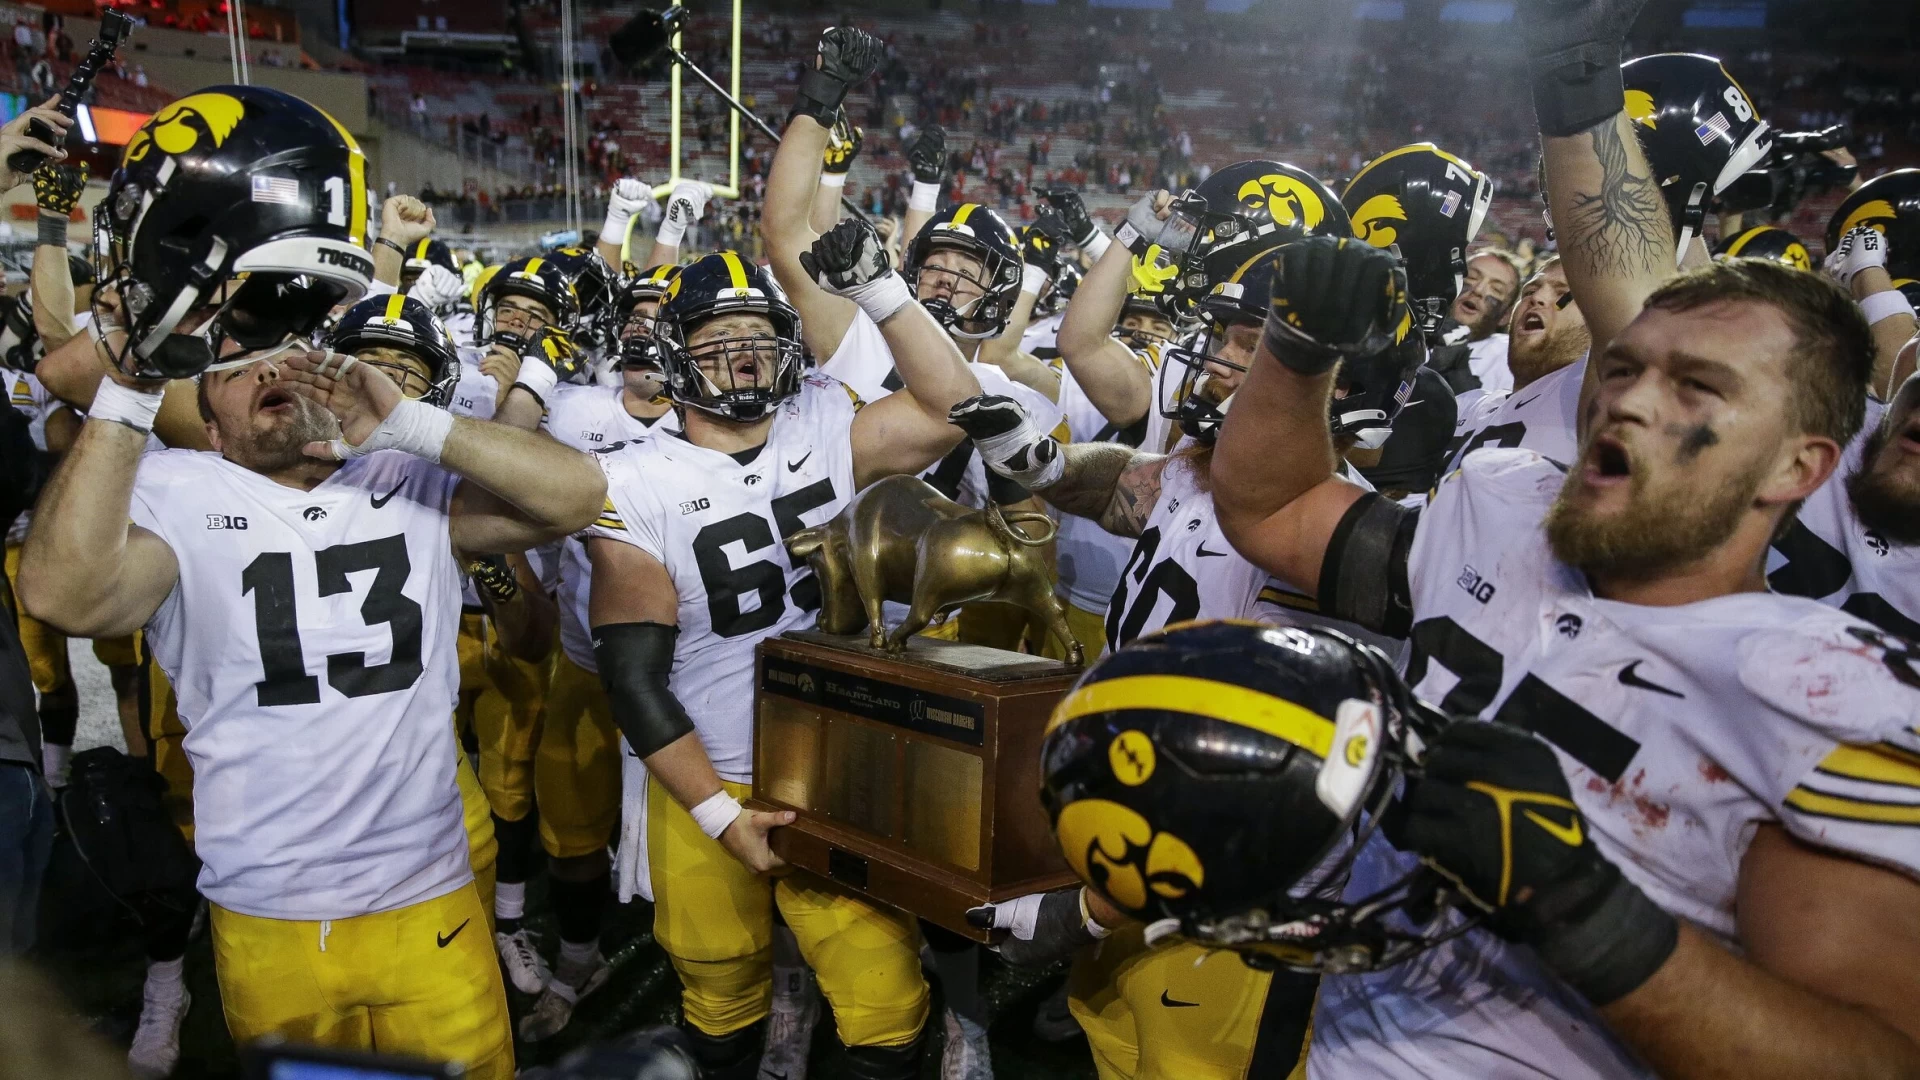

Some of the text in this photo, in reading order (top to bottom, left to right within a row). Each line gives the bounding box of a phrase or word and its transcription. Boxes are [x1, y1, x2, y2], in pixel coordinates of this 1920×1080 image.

[1723, 86, 1752, 122] 8
[1445, 162, 1471, 186] 7
[692, 477, 837, 638] 65
[242, 533, 424, 706] 13
